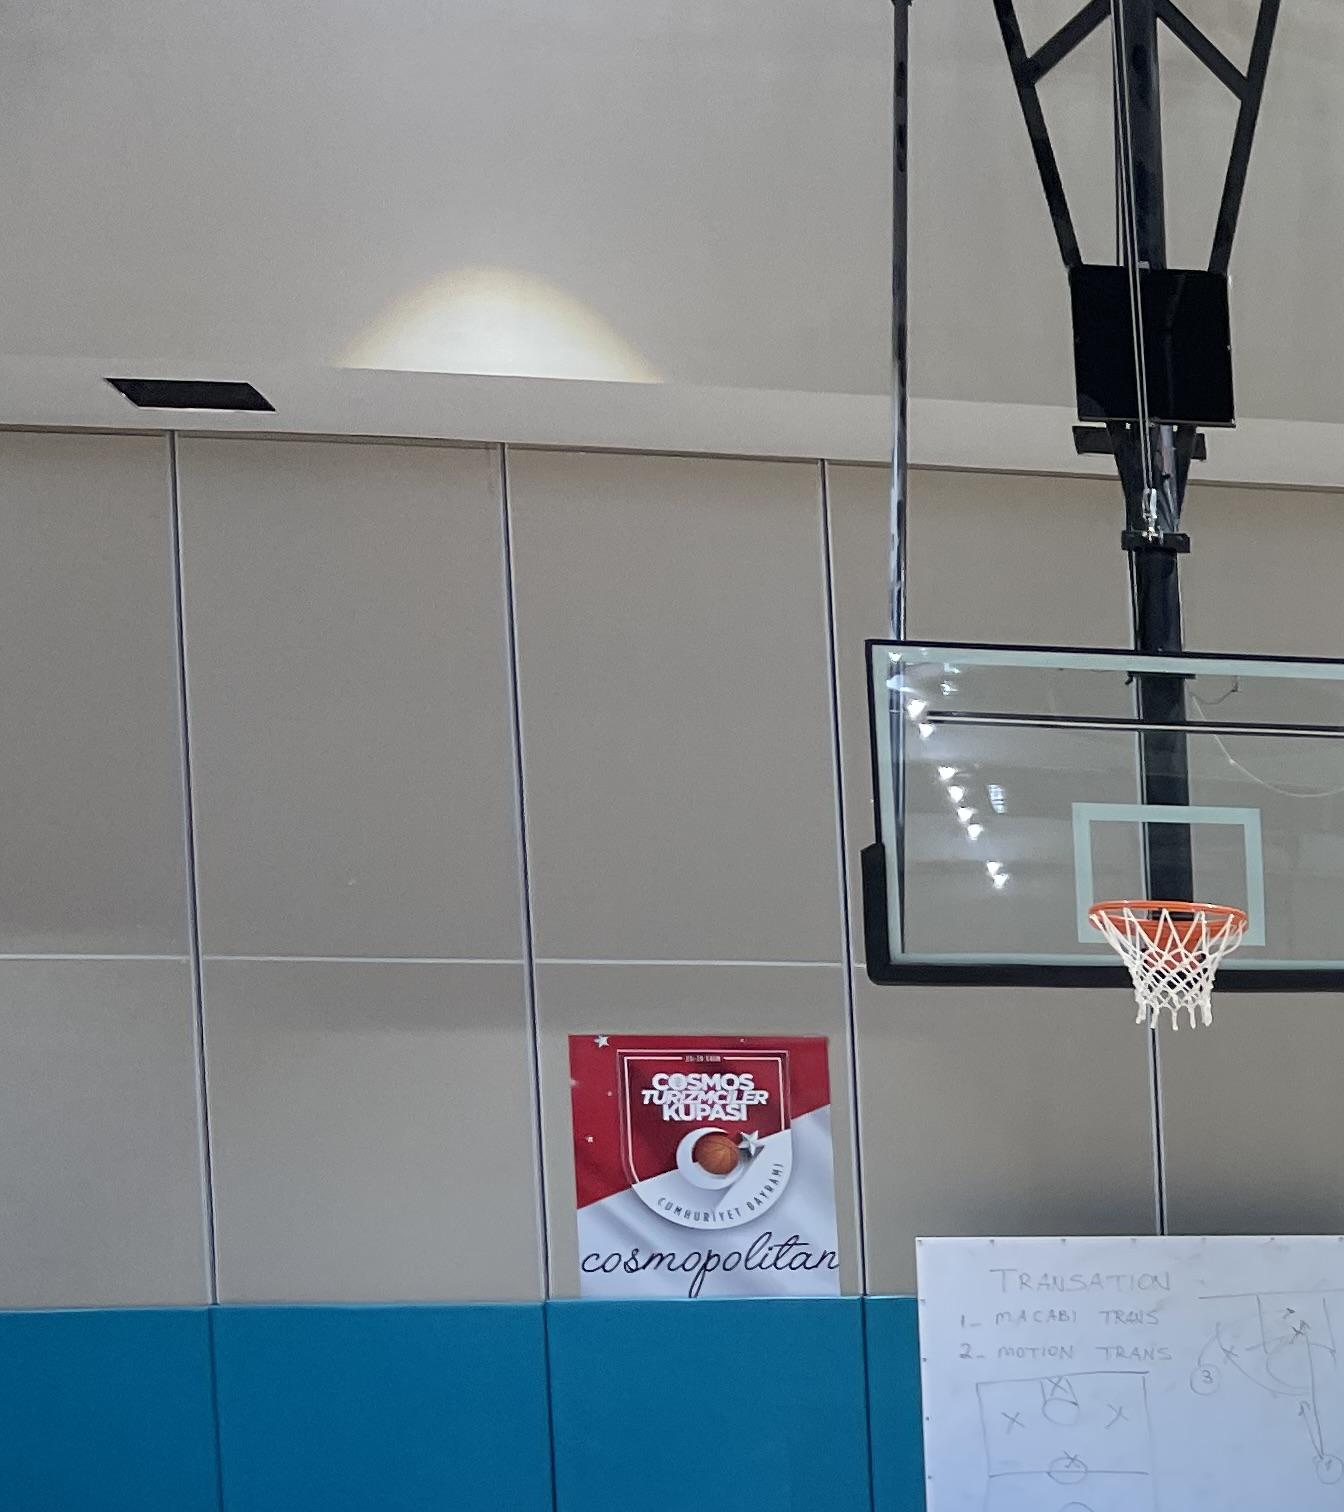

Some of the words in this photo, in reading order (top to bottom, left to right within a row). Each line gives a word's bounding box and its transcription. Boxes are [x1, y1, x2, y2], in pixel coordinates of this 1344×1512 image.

[652, 1073, 755, 1090] COSMOS
[662, 1103, 748, 1121] KUPASI
[581, 1232, 840, 1298] cosmopolitan
[990, 1268, 1171, 1293] TRANSATION
[998, 1345, 1074, 1360] MOTION
[1096, 1346, 1172, 1361] TRANS
